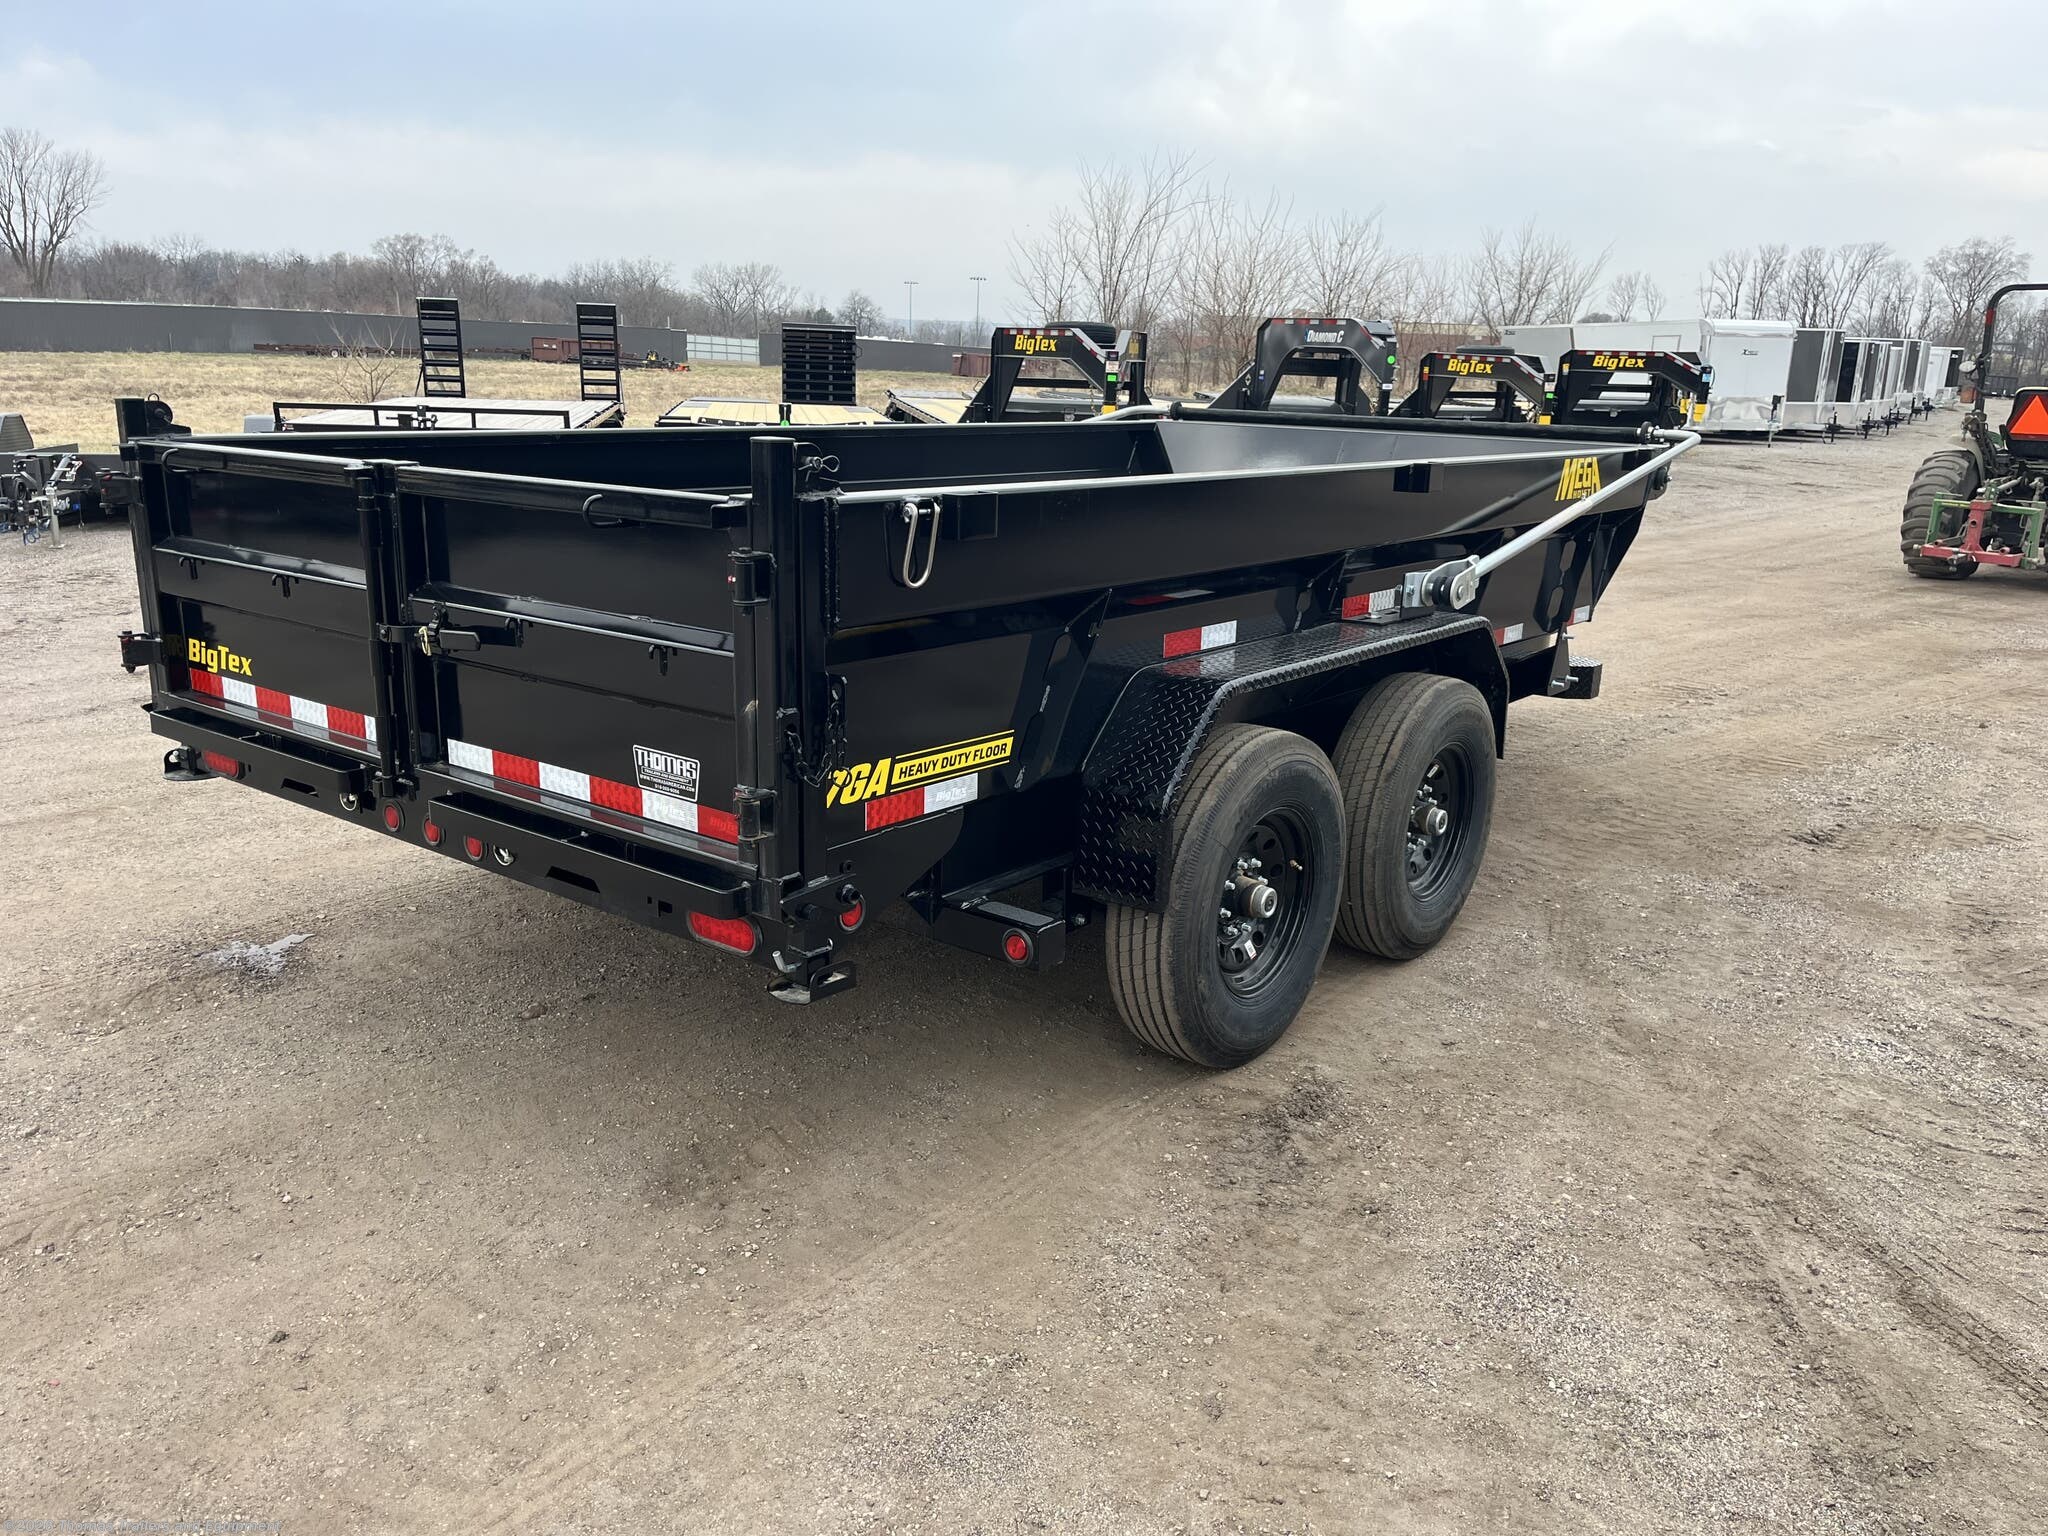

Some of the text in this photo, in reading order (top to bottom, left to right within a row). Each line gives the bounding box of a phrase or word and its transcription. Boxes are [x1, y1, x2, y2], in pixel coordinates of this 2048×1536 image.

[1014, 335, 1057, 355] BigTex
[1306, 330, 1345, 343] DIAMOND C
[1447, 358, 1494, 376] BigTex
[1592, 355, 1646, 371] BigTex
[1554, 457, 1601, 502] MEGA
[188, 638, 253, 677] BigTex
[635, 748, 697, 779] THOMAS
[898, 758, 940, 780] HEAVY
[940, 750, 972, 770] DUTY
[972, 742, 1008, 762] FLOOR
